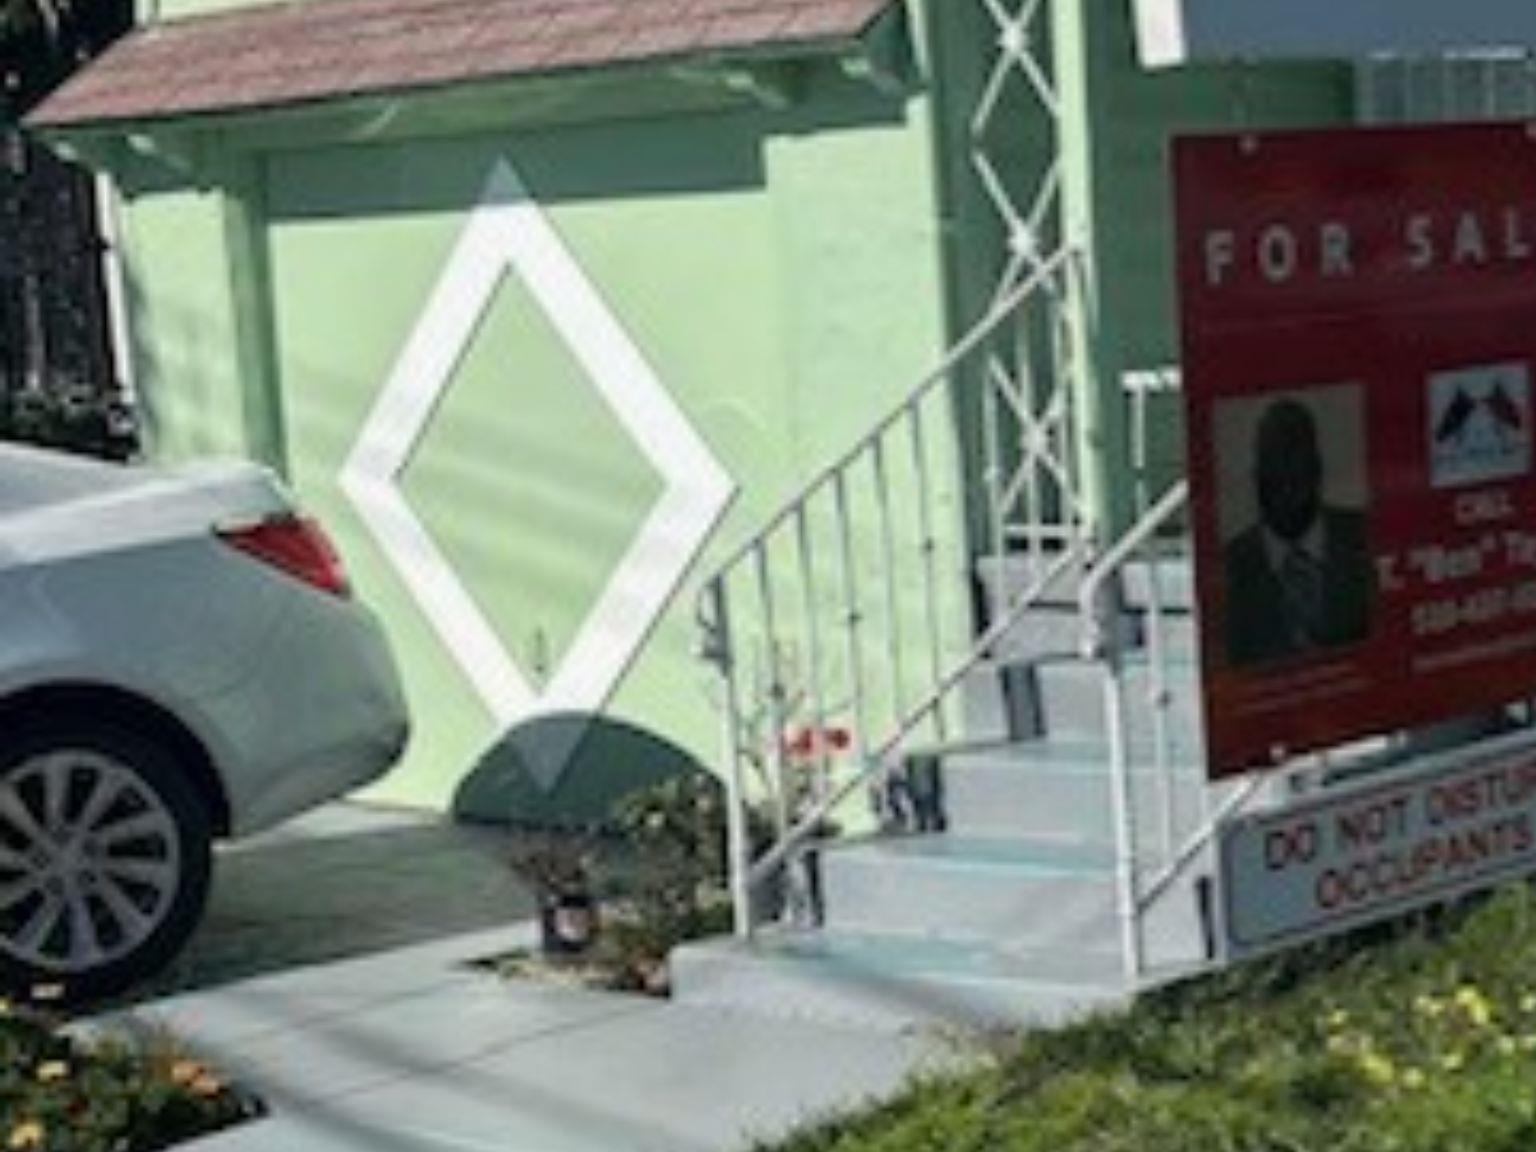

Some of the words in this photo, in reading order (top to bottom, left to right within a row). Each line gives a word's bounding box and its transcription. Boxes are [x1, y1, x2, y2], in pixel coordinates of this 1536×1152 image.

[1206, 222, 1353, 285] FOR
[1265, 823, 1317, 870] DO
[1339, 797, 1410, 845] NOT
[1316, 813, 1533, 908] OCCUPANTS
